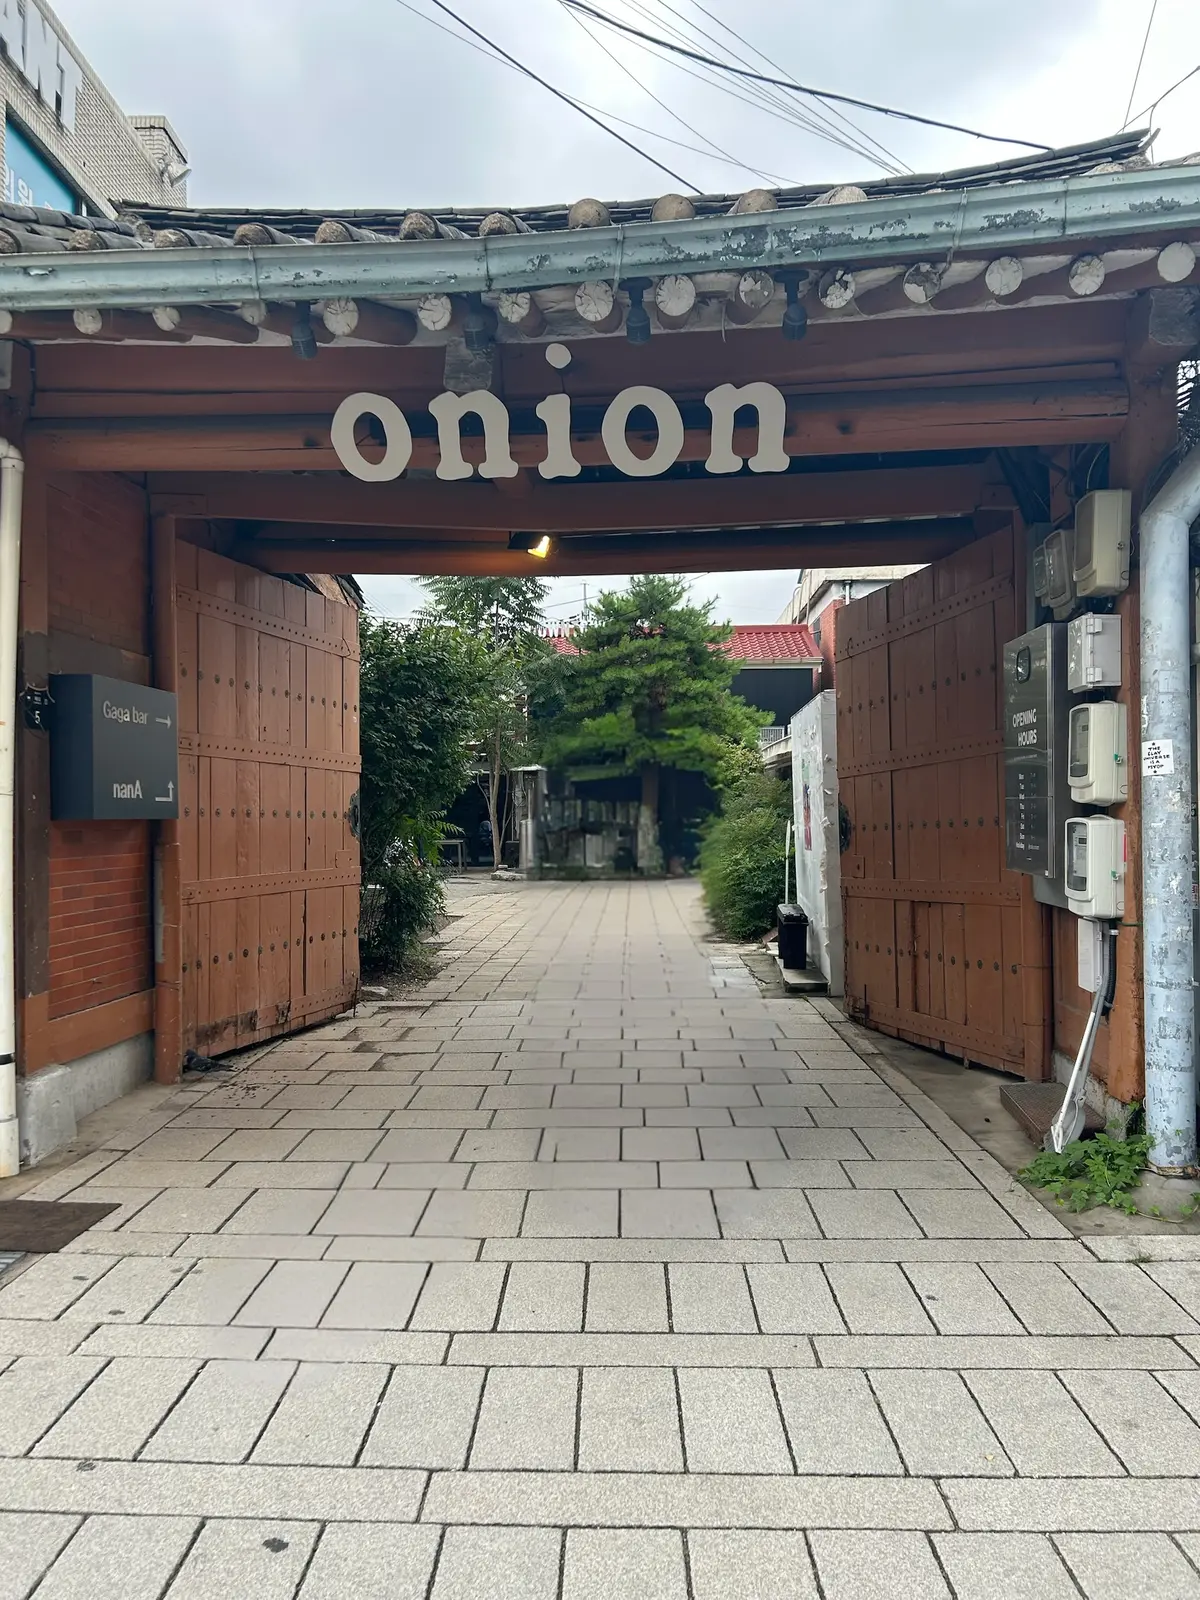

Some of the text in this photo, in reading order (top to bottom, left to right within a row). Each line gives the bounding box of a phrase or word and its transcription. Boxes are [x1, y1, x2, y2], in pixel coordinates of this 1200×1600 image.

[331, 343, 790, 482] onion
[35, 710, 41, 724] 5
[103, 700, 148, 724] Gaga bar
[1012, 708, 1037, 727] OPENING
[1017, 729, 1038, 746] HOURS
[113, 780, 143, 799] nanA
